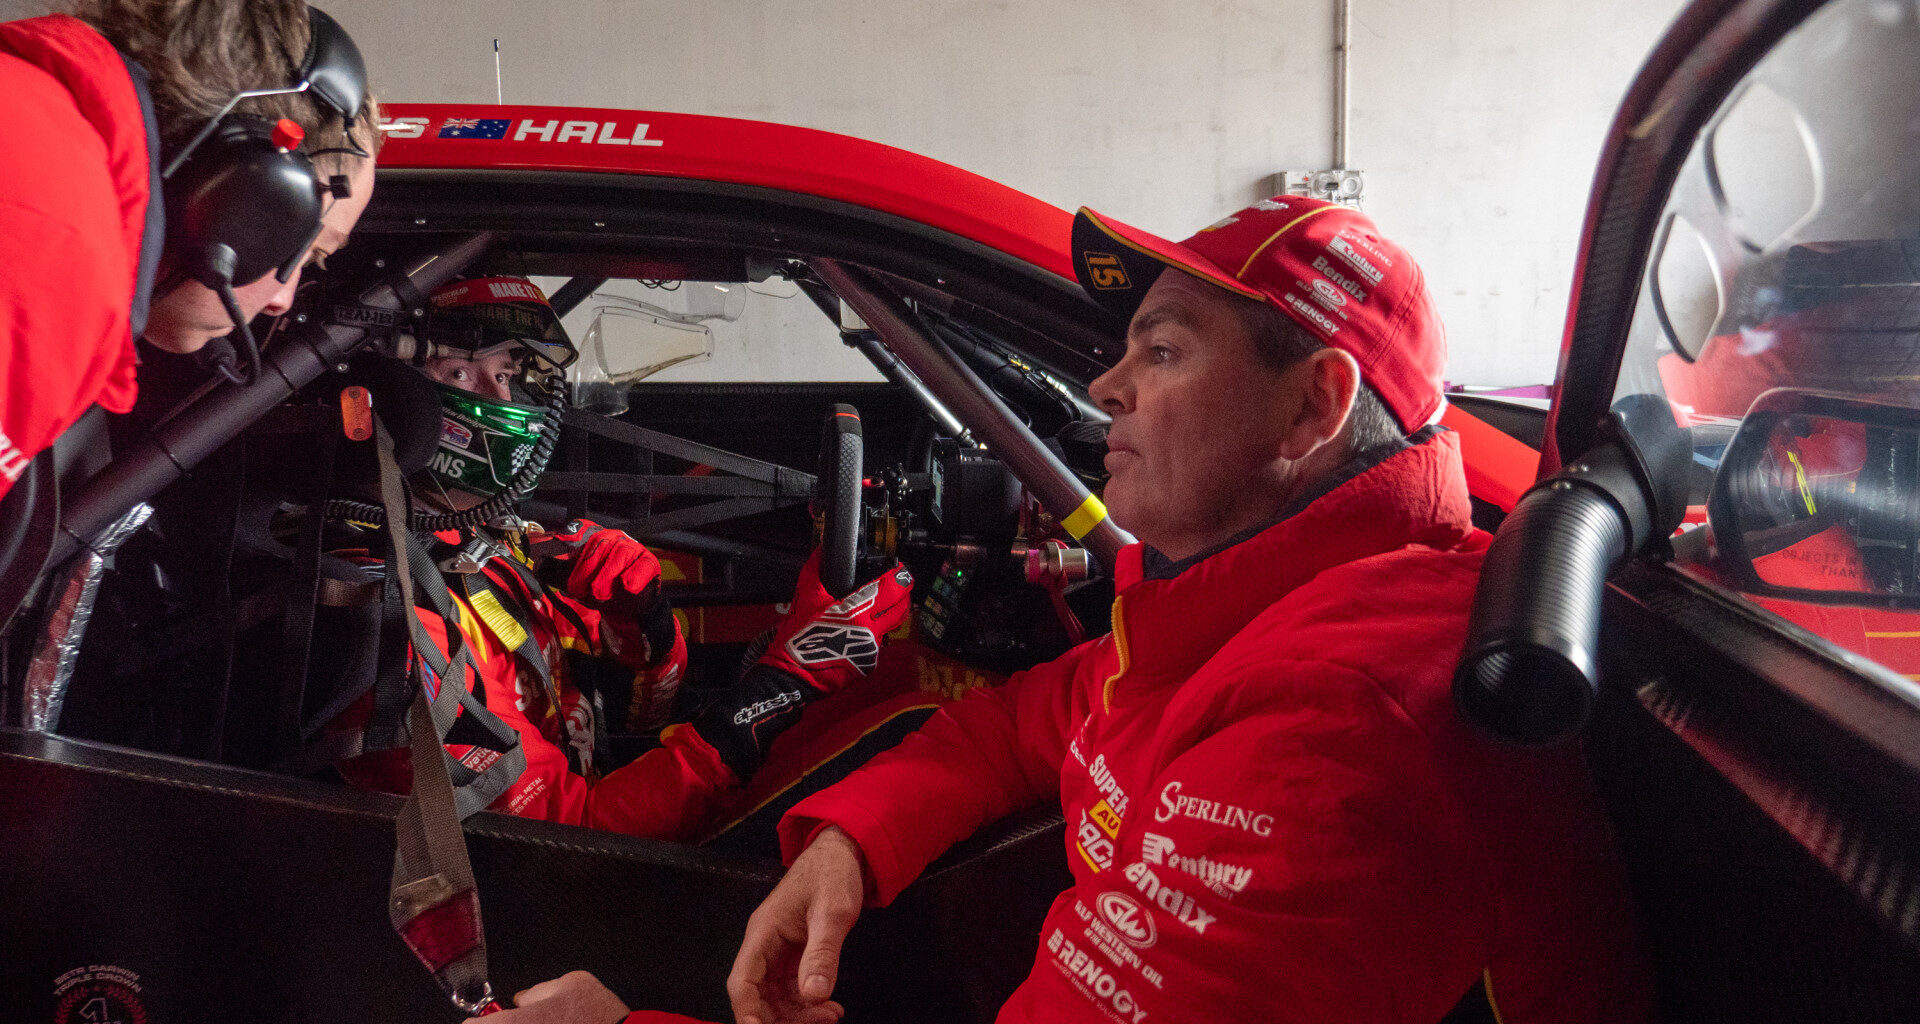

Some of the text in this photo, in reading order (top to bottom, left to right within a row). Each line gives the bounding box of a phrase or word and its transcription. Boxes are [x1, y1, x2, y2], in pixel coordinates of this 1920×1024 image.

[513, 119, 664, 147] HALL
[1338, 230, 1393, 267] SPERLING
[1089, 257, 1126, 286] 15
[1312, 255, 1367, 303] Bendix
[488, 282, 538, 300] MAKE IT
[1293, 299, 1340, 333] RENOGY
[1782, 549, 1839, 564] OBJECTS
[1820, 565, 1857, 578] THAN
[523, 776, 544, 795] METAL
[523, 794, 535, 806] PTY
[534, 783, 547, 796] LTD
[1097, 809, 1120, 831] AU
[1154, 780, 1275, 838] SPERLING
[1077, 808, 1114, 871] ACI
[1142, 832, 1253, 892] Century
[1123, 861, 1217, 935] endix
[1090, 916, 1142, 970] WESTERN
[1141, 964, 1164, 990] OIL
[88, 965, 141, 981] DARWIN
[96, 972, 142, 993] CROWN
[1058, 938, 1148, 1024] RENOGY
